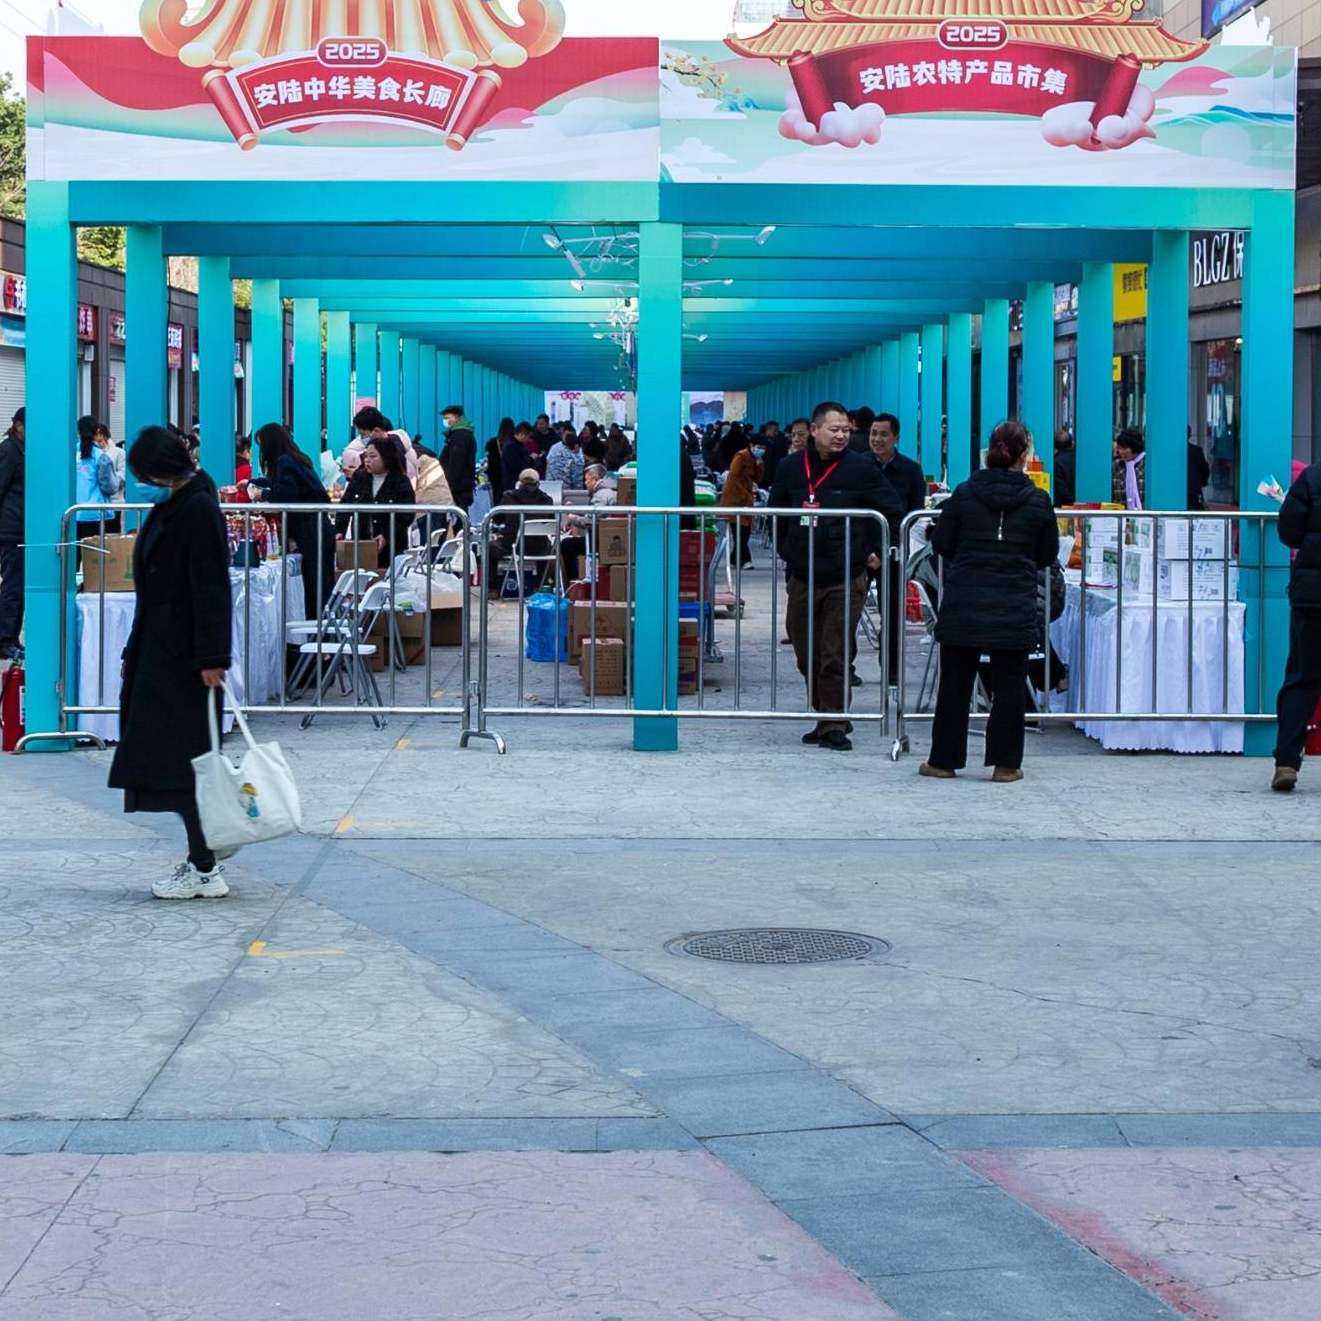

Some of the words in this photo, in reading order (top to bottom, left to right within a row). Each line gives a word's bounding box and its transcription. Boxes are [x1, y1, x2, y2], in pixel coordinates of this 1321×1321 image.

[325, 43, 380, 60] 2025
[946, 26, 1001, 42] 2025
[253, 76, 453, 111] 安陆中华美食长廊
[859, 59, 1068, 96] 安陆农特产品市集
[1193, 233, 1230, 287] BLGZ
